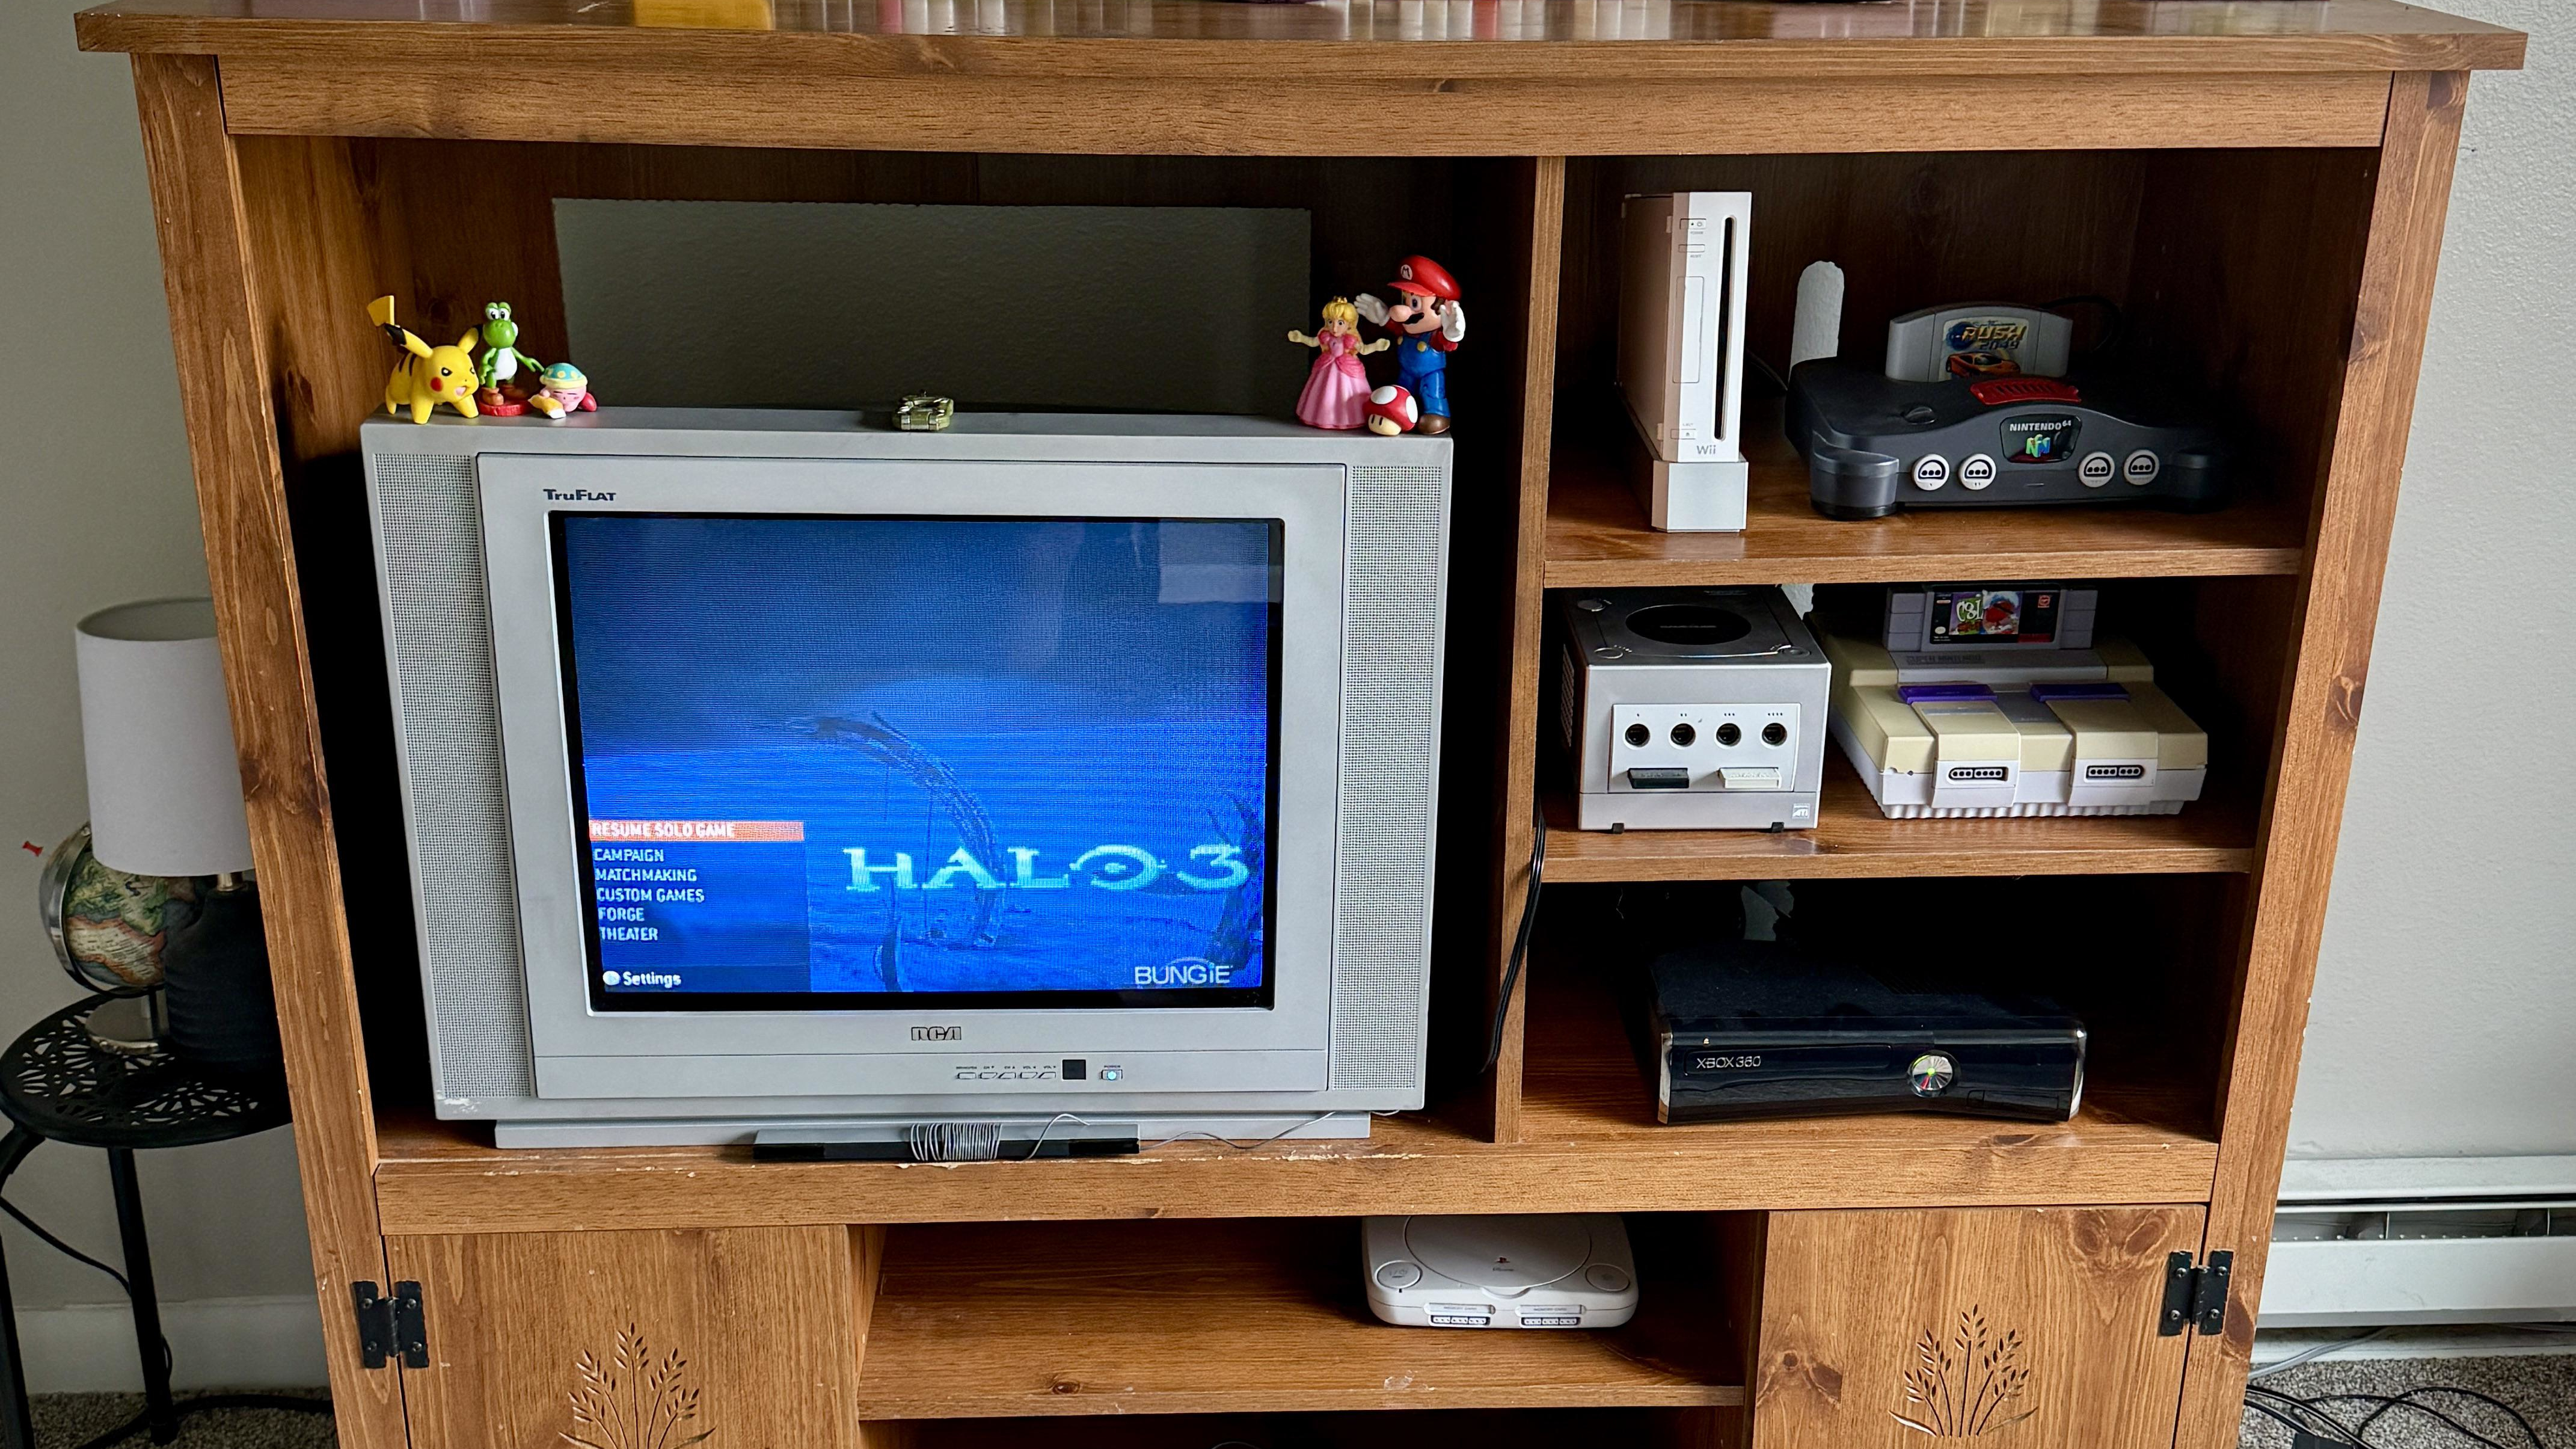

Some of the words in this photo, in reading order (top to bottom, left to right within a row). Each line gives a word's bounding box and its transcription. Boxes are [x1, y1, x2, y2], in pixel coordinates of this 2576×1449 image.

[1402, 266, 1411, 278] M
[1961, 325, 2027, 341] RUSH
[2010, 422, 2062, 431] NINTENDO
[1696, 445, 1716, 455] Wii
[592, 822, 651, 837] RESUME
[654, 822, 692, 837] SOLO
[695, 822, 735, 837] GAME
[593, 848, 664, 862] CAMPAIGN
[594, 868, 698, 882] MATCHMAKING
[842, 844, 1168, 893] HALO
[1176, 843, 1249, 889] 3
[596, 887, 652, 902] CUSTOM
[656, 888, 705, 903] GAMES
[598, 906, 645, 922] FORGE
[600, 927, 658, 941] THEATER
[623, 971, 681, 989] Settings
[911, 1026, 961, 1041] RCA
[1696, 1057, 1734, 1068] XBOX
[1735, 1056, 1761, 1068] 360
